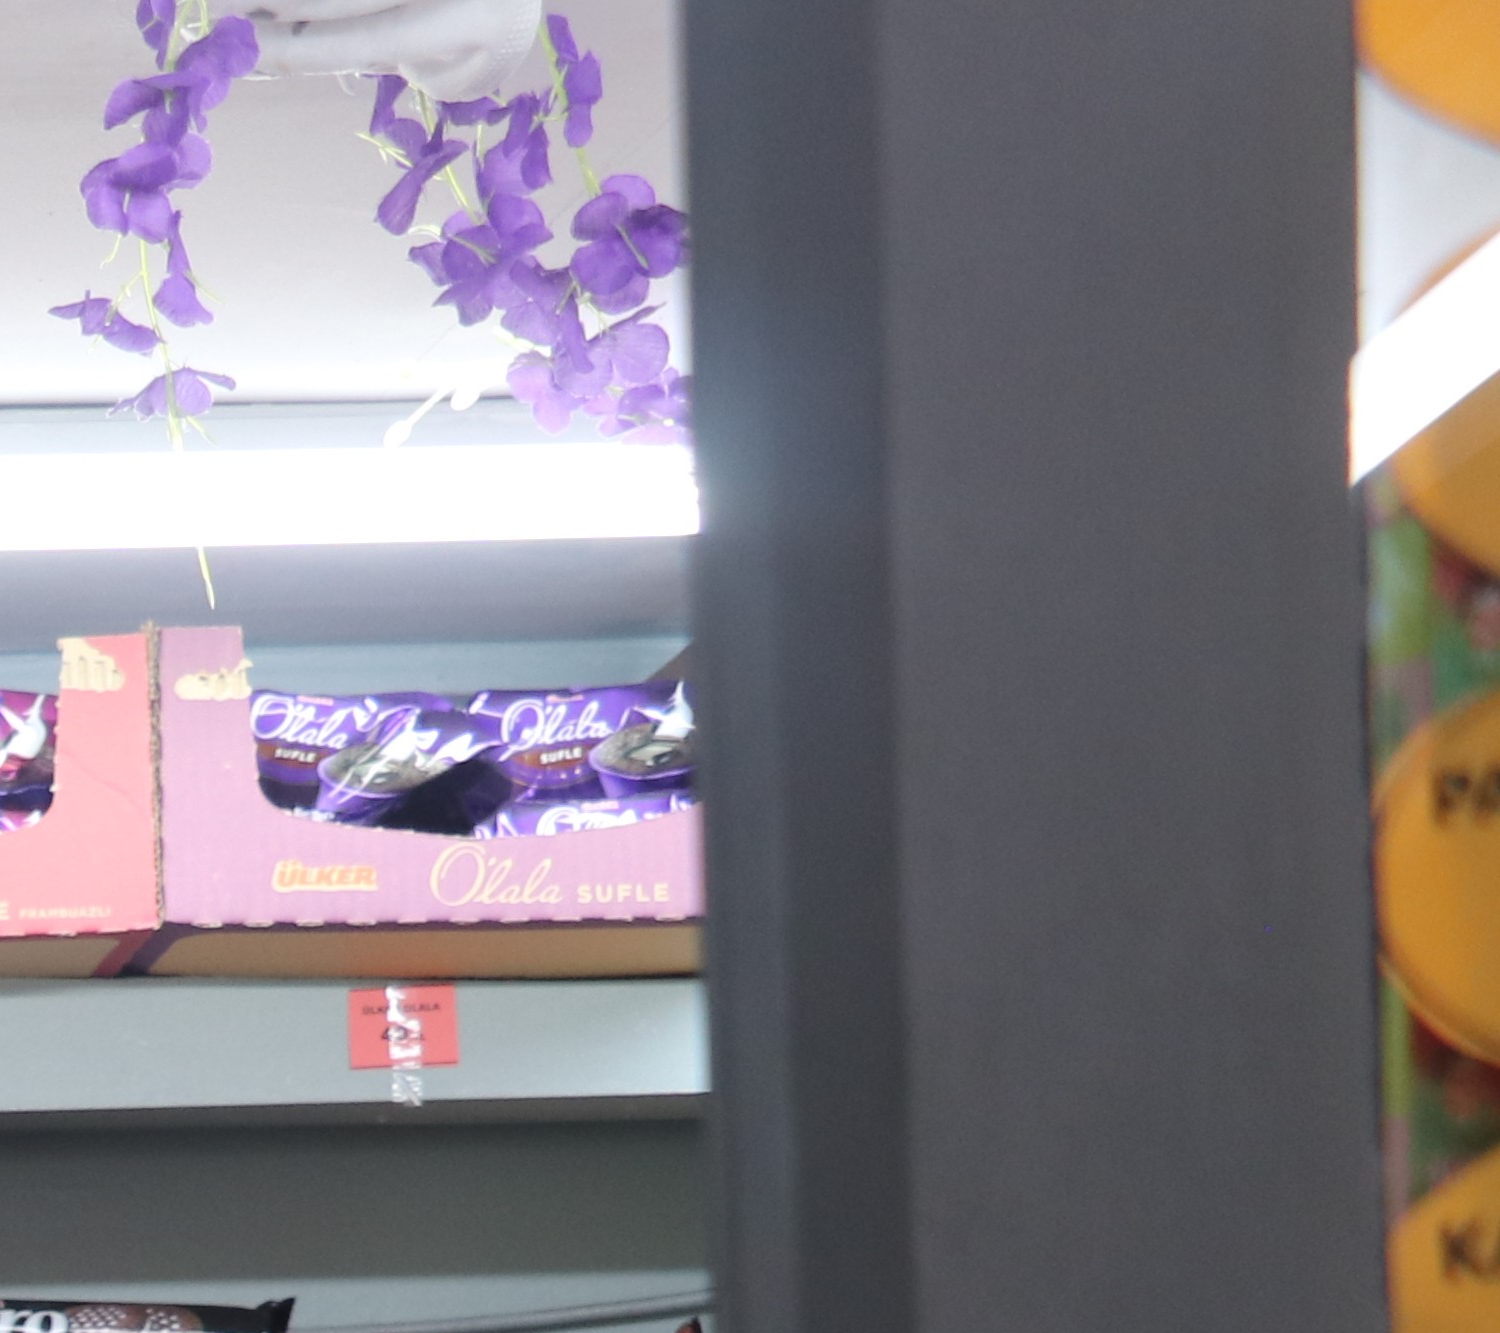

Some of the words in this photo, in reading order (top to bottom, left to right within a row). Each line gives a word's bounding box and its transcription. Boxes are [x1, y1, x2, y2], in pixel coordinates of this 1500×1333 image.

[275, 749, 316, 763] SUFLE
[541, 748, 582, 764] SUFLE
[276, 862, 376, 888] ÜLKER
[431, 843, 564, 906] O'lala
[577, 884, 668, 903] SUFLE
